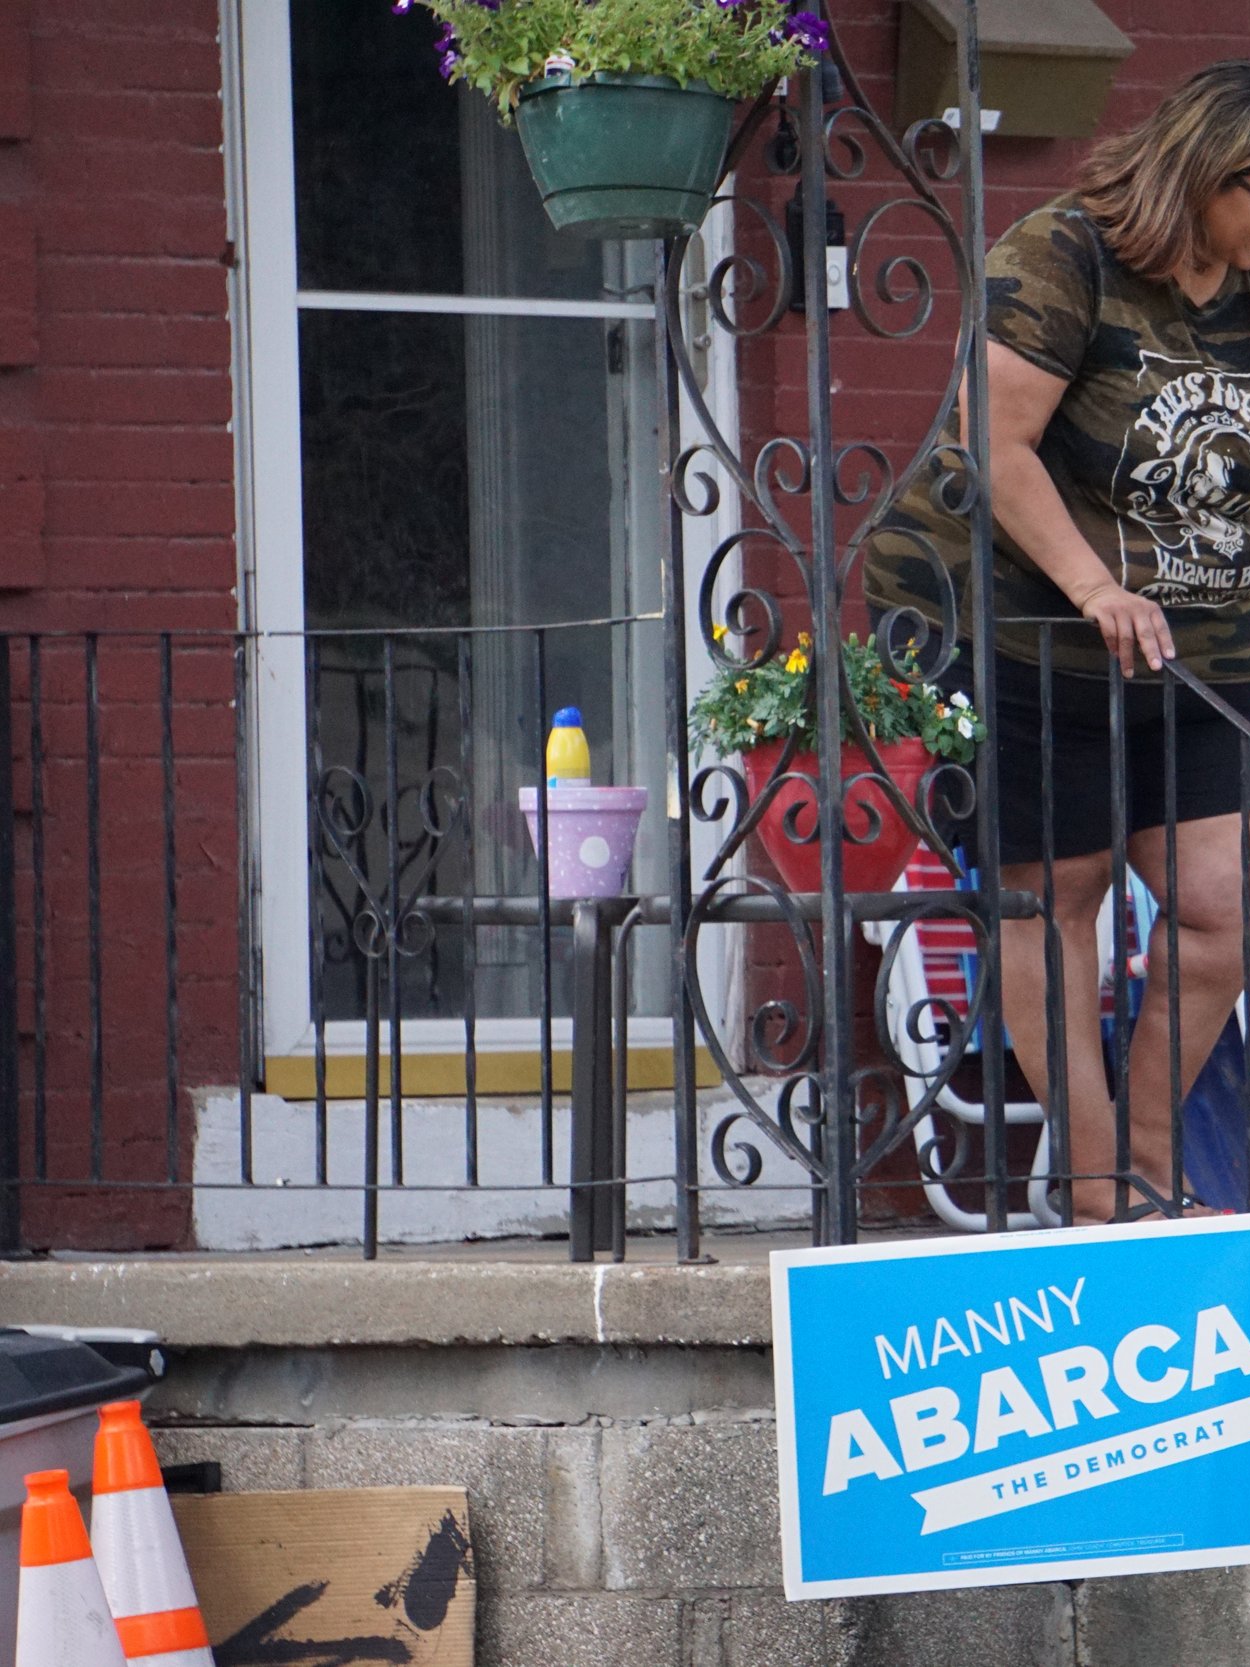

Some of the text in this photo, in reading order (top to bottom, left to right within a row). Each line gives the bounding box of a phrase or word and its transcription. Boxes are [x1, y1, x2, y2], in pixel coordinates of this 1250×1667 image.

[1134, 372, 1206, 456] JANIS
[874, 1277, 1086, 1380] MANNY
[991, 1420, 1227, 1500] THE DEMOCRAT
